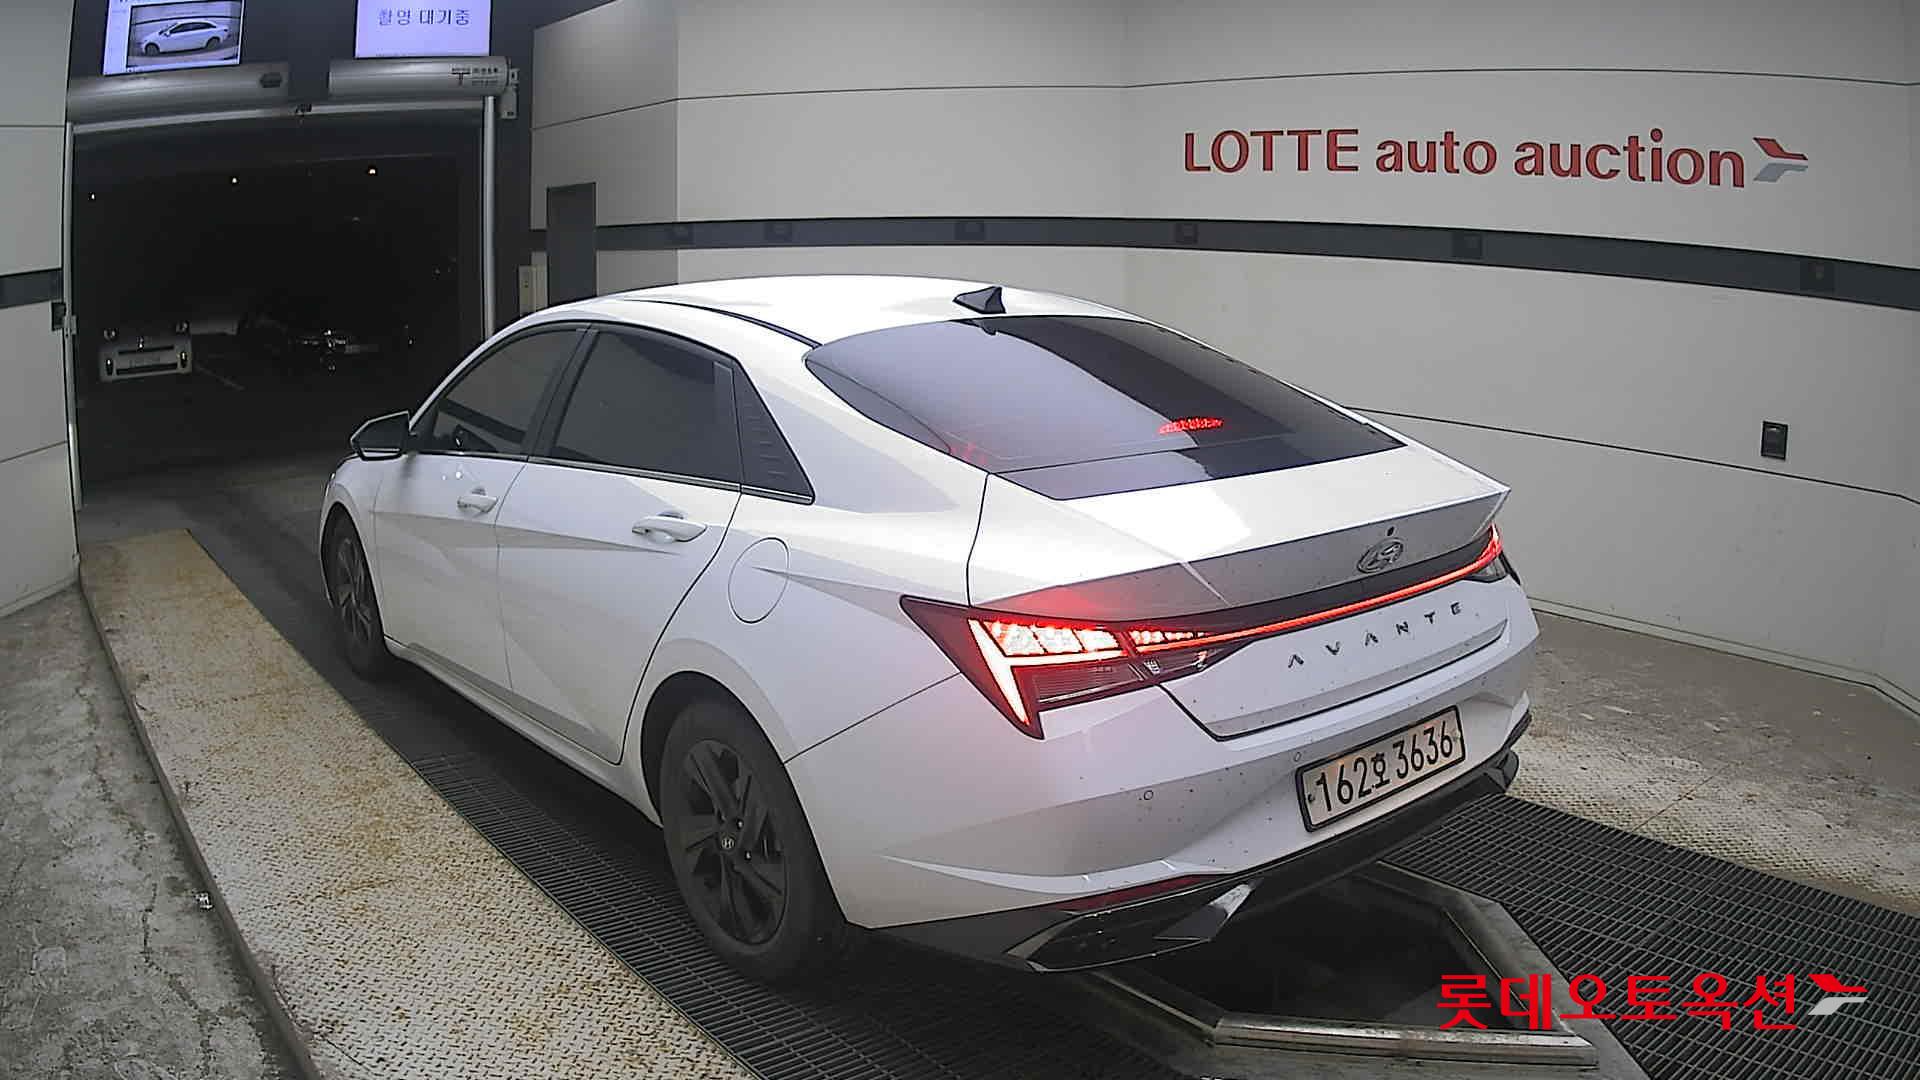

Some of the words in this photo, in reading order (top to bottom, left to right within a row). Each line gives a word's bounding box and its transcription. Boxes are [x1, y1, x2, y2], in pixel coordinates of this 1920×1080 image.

[419, 9, 470, 26] 대기중
[1184, 128, 1360, 173] LOTTE
[1375, 130, 1498, 175] auto
[1513, 128, 1746, 189] auction
[1287, 600, 1463, 669] AVANTE
[1392, 720, 1454, 780] 3636
